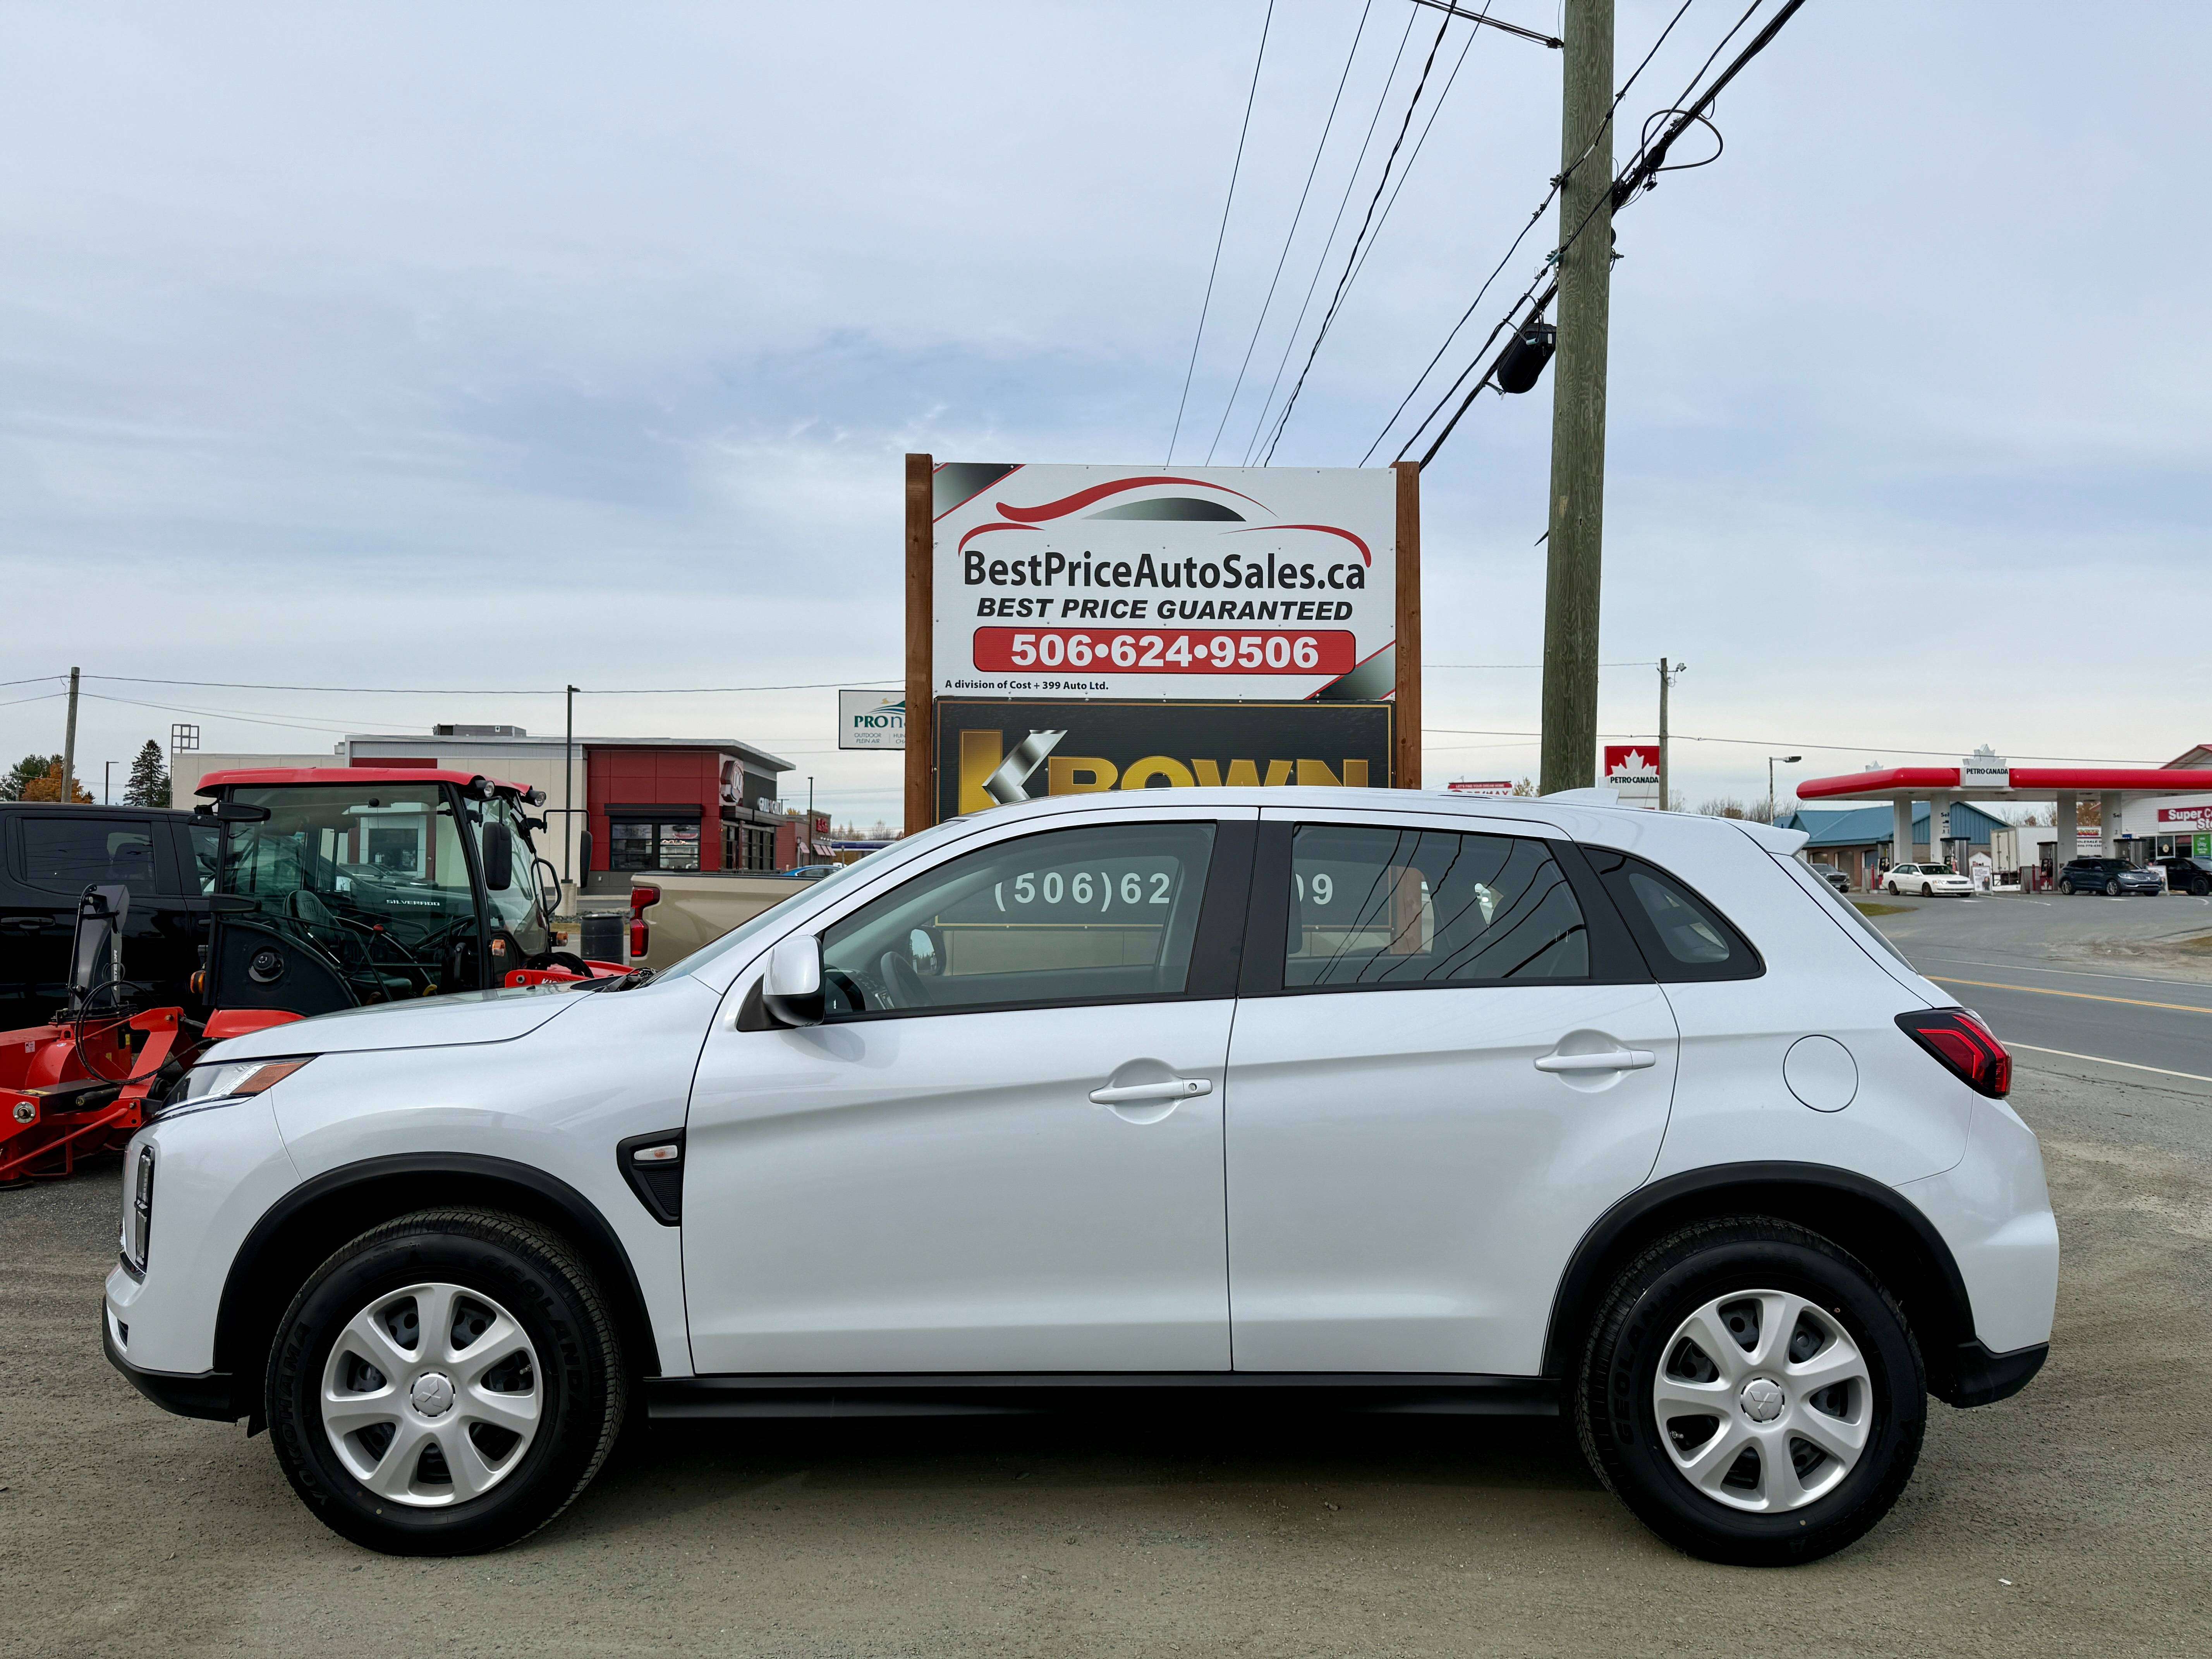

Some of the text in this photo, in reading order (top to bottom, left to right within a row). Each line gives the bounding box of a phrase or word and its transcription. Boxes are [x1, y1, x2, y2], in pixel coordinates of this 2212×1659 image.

[964, 551, 1365, 590] BestPriceAutoSales.ca
[977, 598, 1353, 620] BEST PRICE GUARANTEED
[955, 680, 994, 689] division
[997, 680, 1008, 689] of
[1090, 682, 1108, 690] Ltd.
[2169, 808, 2212, 821] Super C
